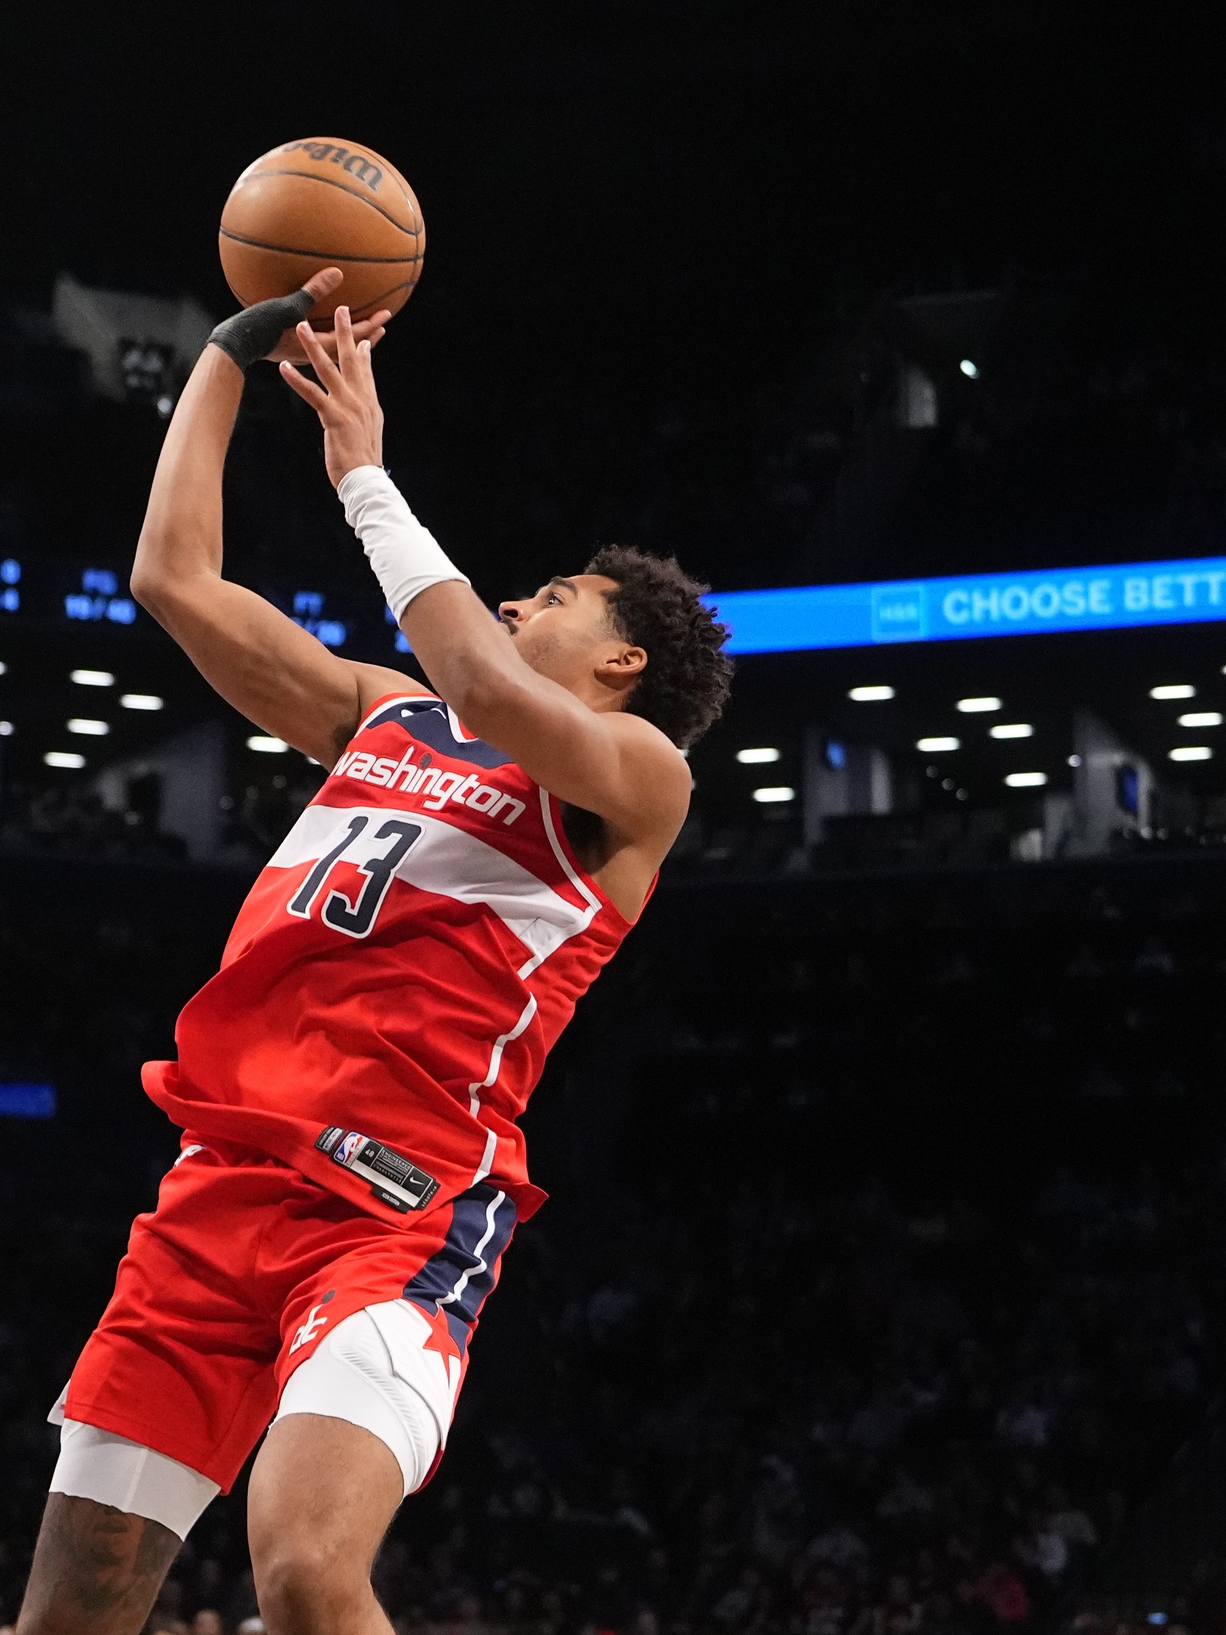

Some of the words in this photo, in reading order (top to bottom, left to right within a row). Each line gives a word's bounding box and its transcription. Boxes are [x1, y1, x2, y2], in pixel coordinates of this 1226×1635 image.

[943, 581, 1111, 624] CHOOSE
[1124, 571, 1226, 609] BETT
[329, 745, 527, 827] washington
[287, 812, 425, 939] 13
